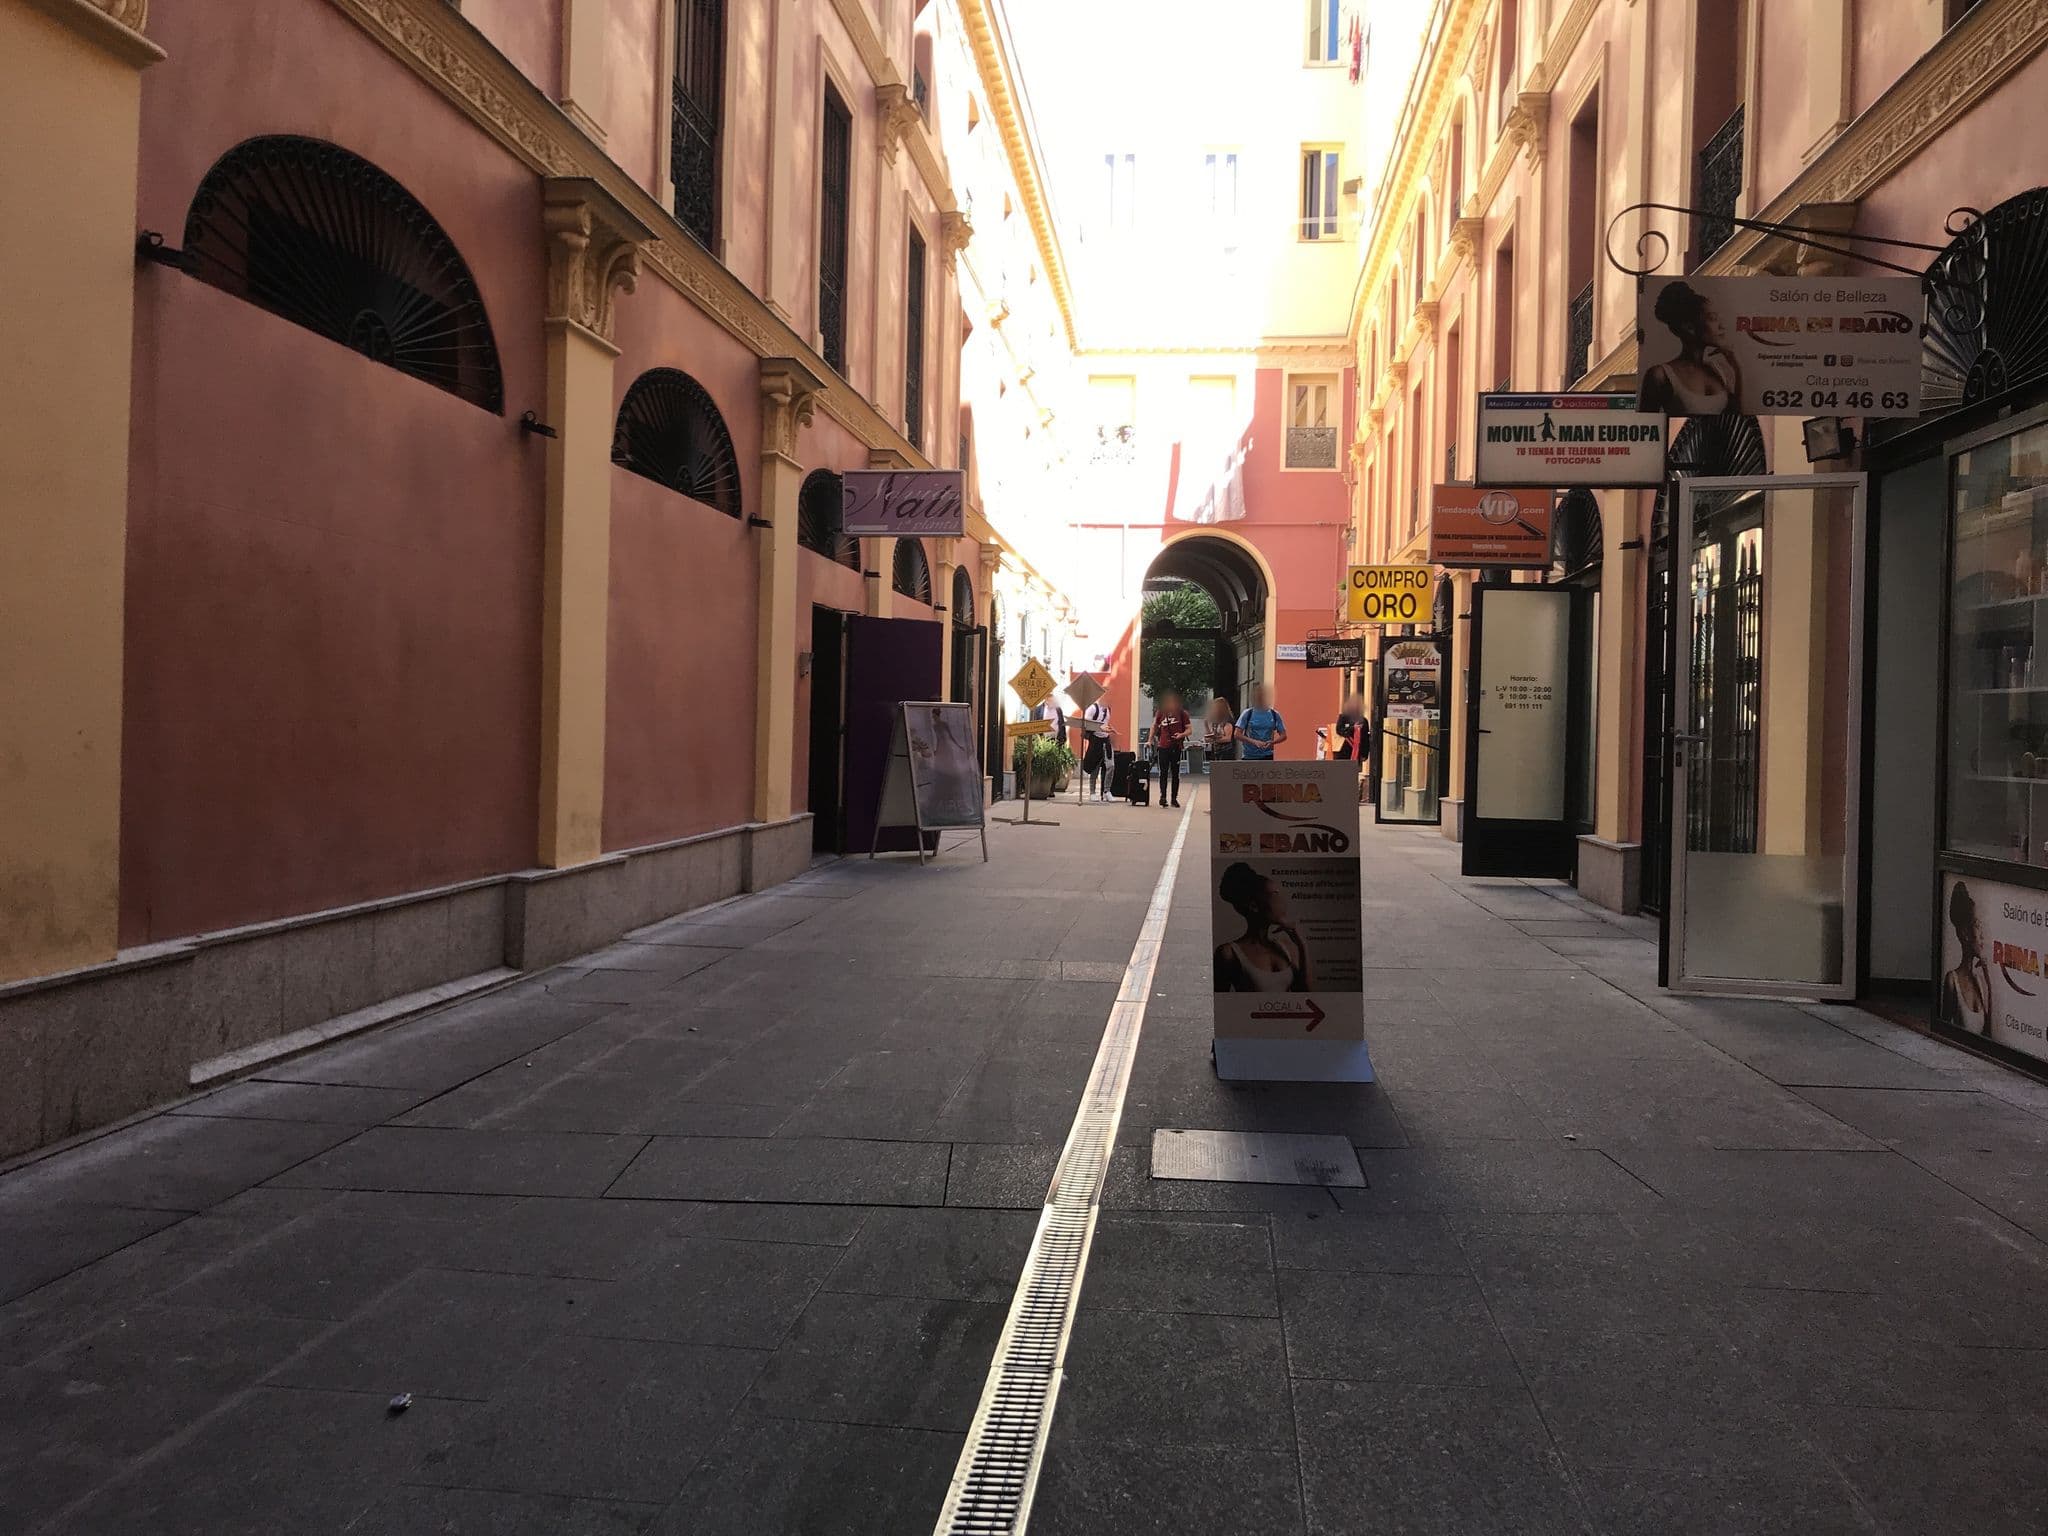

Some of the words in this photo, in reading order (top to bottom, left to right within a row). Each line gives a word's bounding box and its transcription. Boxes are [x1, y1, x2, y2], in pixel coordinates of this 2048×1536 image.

[1769, 289, 1809, 303] Salón
[1813, 290, 1832, 303] de
[1836, 290, 1887, 303] Belleza
[1736, 316, 1801, 335] REINA
[1806, 316, 1833, 334] DE
[1839, 314, 1913, 334] EBANO
[1806, 375, 1829, 386] Cita
[1833, 376, 1869, 390] previa
[1762, 390, 1803, 408] 632
[1811, 391, 1838, 408] 04
[1846, 391, 1873, 409] 46
[1881, 392, 1908, 409] 63
[1487, 425, 1537, 443] MOVIL
[1559, 425, 1595, 442] MAN
[1598, 425, 1661, 442] EUROPA
[1528, 447, 1555, 456] TIENDA
[1556, 447, 1565, 456] DE
[1607, 447, 1631, 456] MOVIL
[1545, 457, 1602, 465] FOTOCOPIAS
[1353, 570, 1429, 589] COMPRO
[1363, 593, 1417, 619] ORO
[1405, 658, 1423, 666] VALE
[1266, 768, 1282, 780] de
[1242, 783, 1323, 804] REINA
[1219, 832, 1252, 853] DE
[1260, 830, 1350, 854] EBANO
[2003, 902, 2028, 923] Salón
[2030, 910, 2043, 926] de
[1993, 940, 2040, 977] REINA
[1258, 1001, 1294, 1011] LOCAL
[2005, 1014, 2020, 1031] Cita
